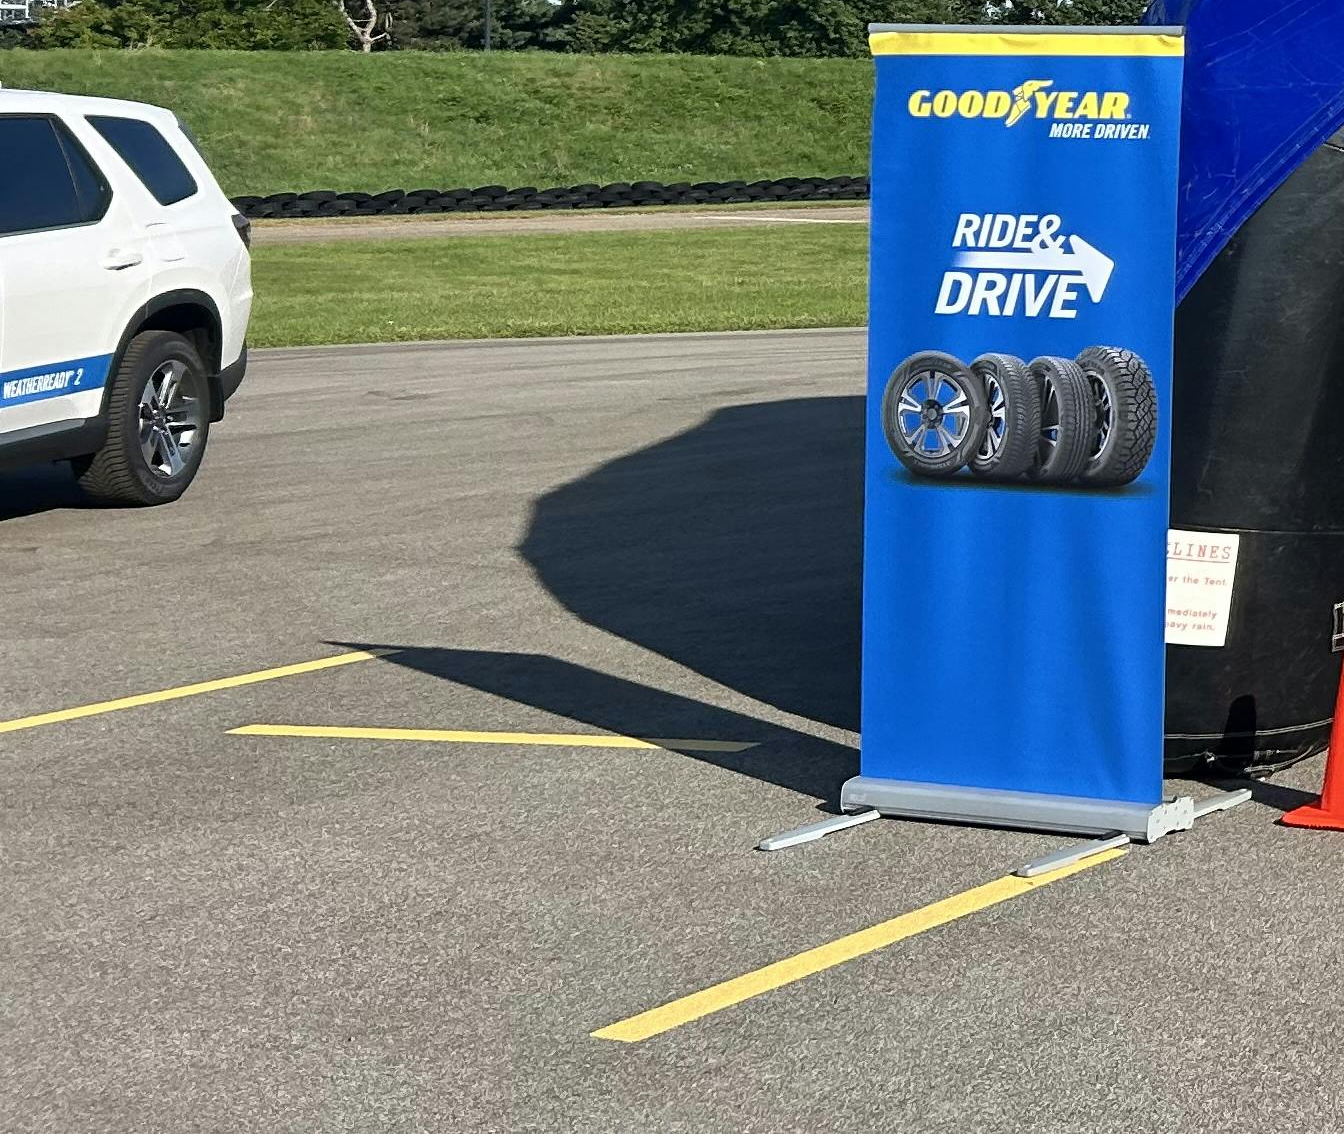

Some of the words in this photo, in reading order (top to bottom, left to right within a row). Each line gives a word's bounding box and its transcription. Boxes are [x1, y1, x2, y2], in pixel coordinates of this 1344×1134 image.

[908, 90, 1131, 119] GOODYEAR
[1050, 123, 1092, 139] MORE
[934, 271, 1083, 319] DRIVE
[3, 370, 74, 399] WEATHERREADY
[74, 368, 84, 385] 2
[1183, 573, 1199, 584] the
